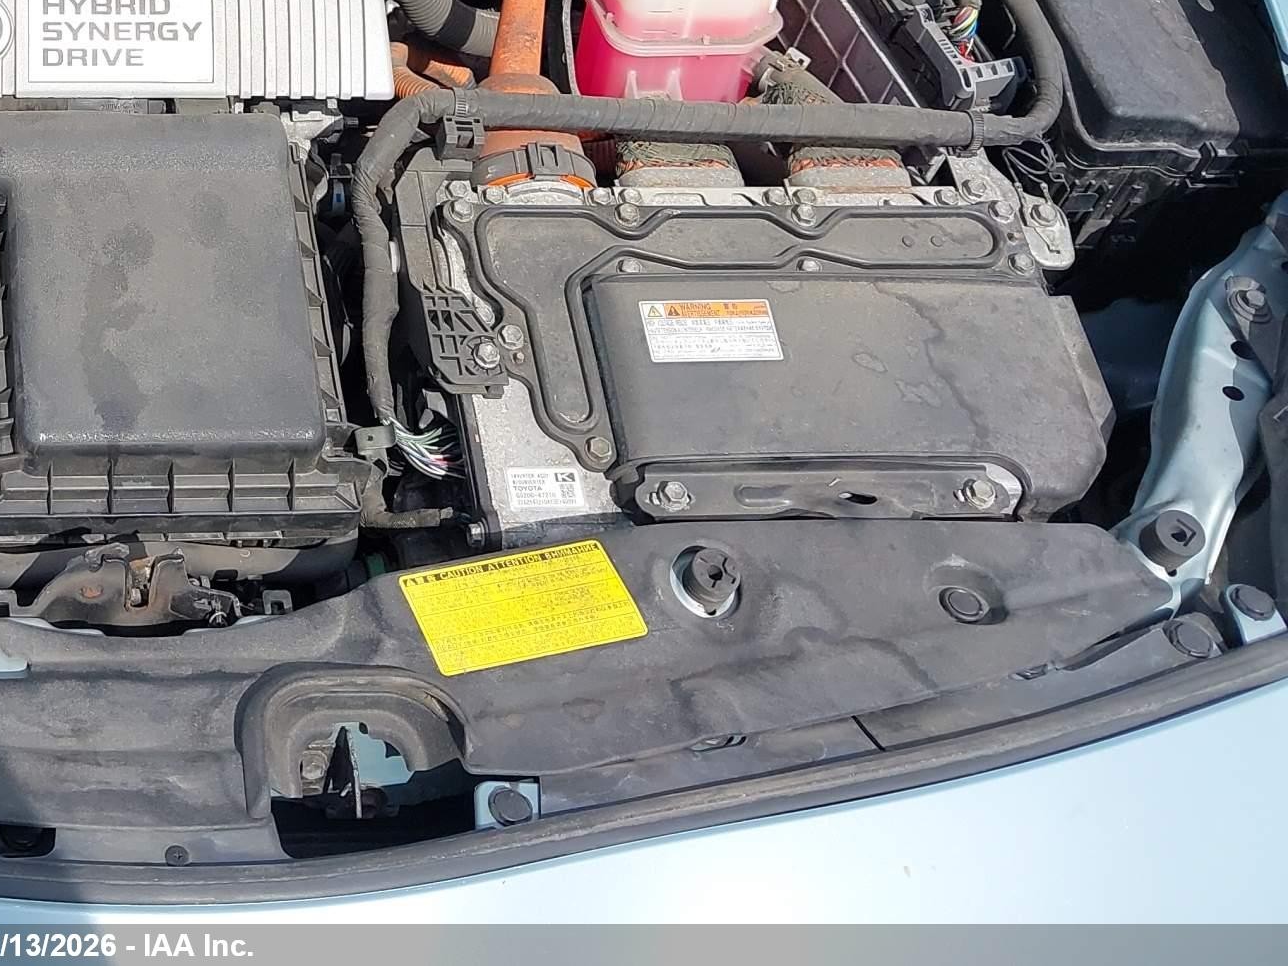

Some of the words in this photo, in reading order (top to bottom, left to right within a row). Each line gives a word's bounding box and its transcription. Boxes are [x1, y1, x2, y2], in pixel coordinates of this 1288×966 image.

[42, 22, 202, 41] SYNERGY
[42, 48, 144, 67] DRIVE
[545, 544, 597, 559] ВНИМАНИЕ
[440, 565, 483, 580] CAUTION
[488, 554, 541, 571] ATTENTION
